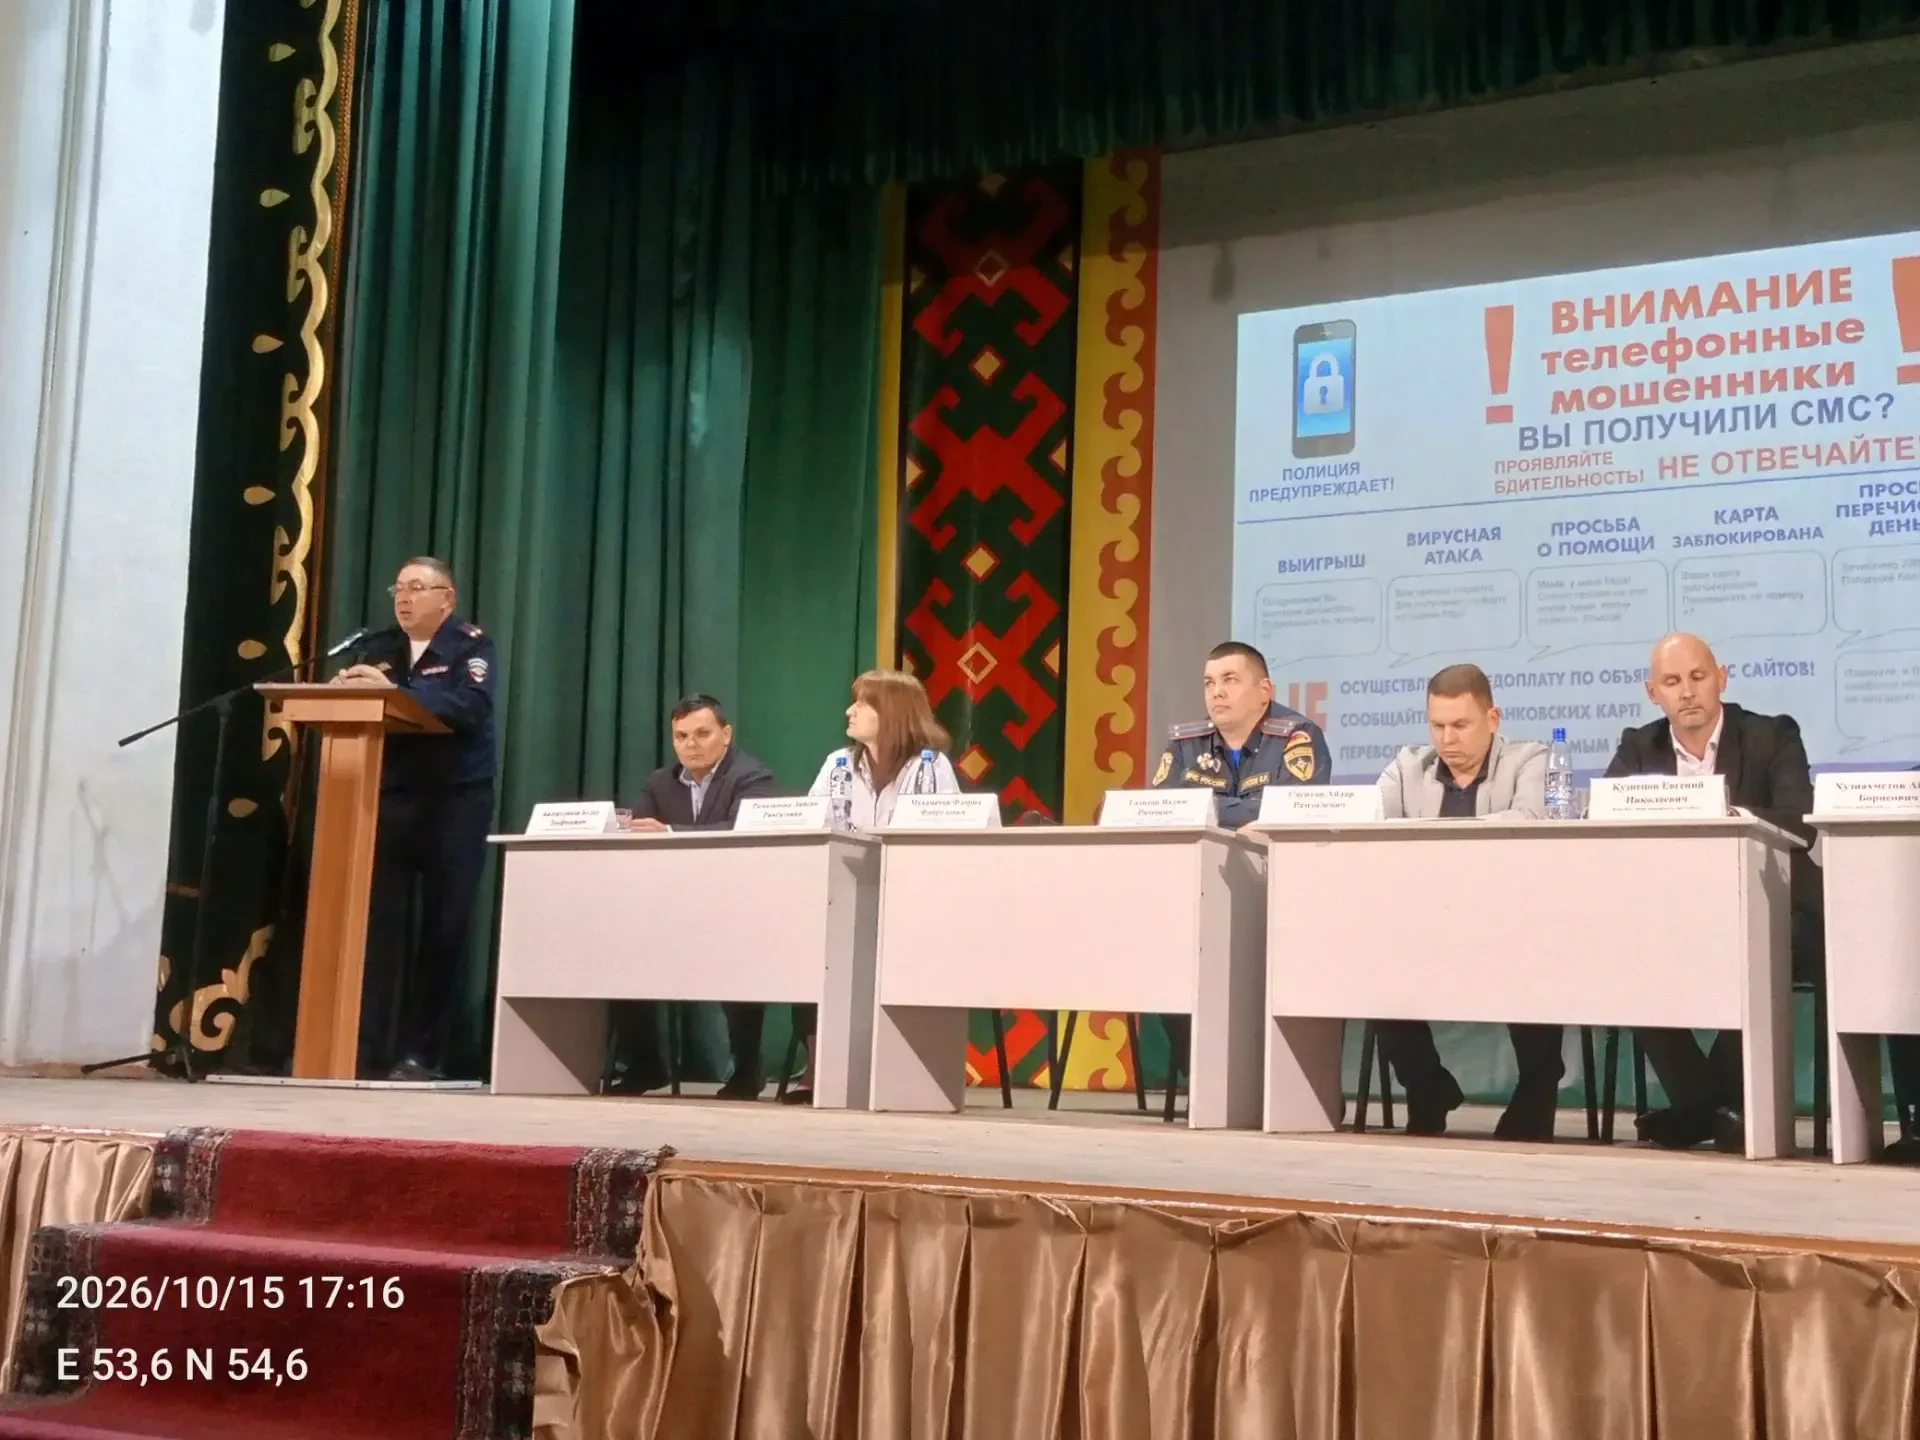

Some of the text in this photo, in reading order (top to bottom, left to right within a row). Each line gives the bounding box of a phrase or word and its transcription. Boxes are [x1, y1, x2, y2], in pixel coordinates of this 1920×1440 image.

[1552, 267, 1853, 334] ВНИМАНИЕ
[1541, 317, 1865, 374] телефонные
[1550, 361, 1855, 415] мошенники
[1518, 391, 1895, 452] ВЫ ПОЛУЧИЛИ СМС?
[1494, 451, 1614, 474] ПРОЯВЛЯЙТЕ
[1658, 433, 1920, 481] НЕ ОТВЕЧАЙТЕ
[1282, 462, 1361, 482] ПОЛИЦИЯ
[1249, 477, 1395, 503] ПРЕДУПРЕЖДАЕТ!
[1859, 481, 1920, 498] ПРОС
[1550, 516, 1642, 537] ПРОСЬБА
[1713, 506, 1780, 525] КАРТА
[1406, 526, 1502, 548] ВИРУСНАЯ
[1536, 535, 1655, 558] О ПОМОЩИ
[1672, 526, 1825, 549] ЗАБЛОКИРОВАНА
[1277, 554, 1367, 574] ВЫИГРЫШ
[1424, 548, 1484, 566] АТАКА
[1340, 677, 1427, 696] ОСУЩЕСТВЛ
[1489, 672, 1566, 690] ДОПЛАТУ
[1570, 670, 1594, 687] ПО
[1741, 658, 1815, 678] САЙТОВ!
[1340, 708, 1428, 728] СООБЩАЙТ
